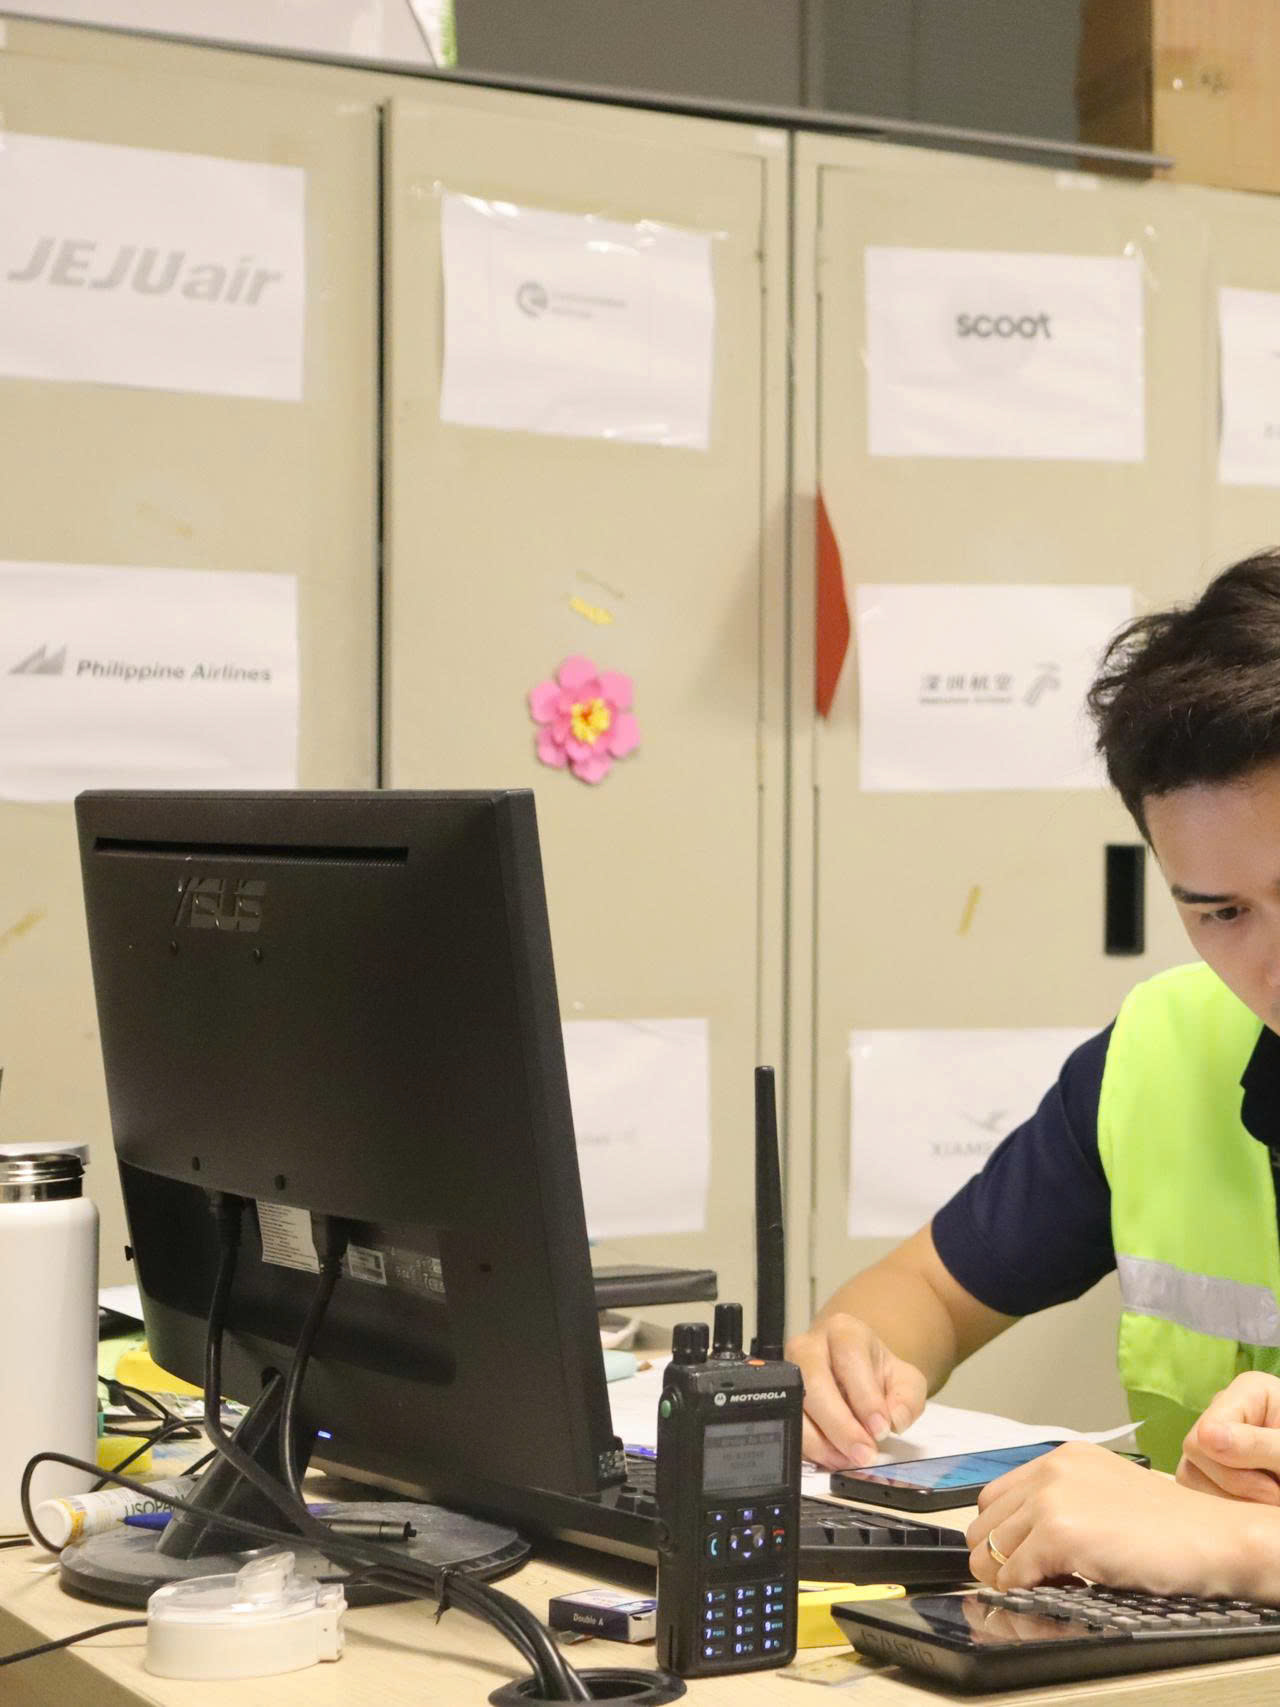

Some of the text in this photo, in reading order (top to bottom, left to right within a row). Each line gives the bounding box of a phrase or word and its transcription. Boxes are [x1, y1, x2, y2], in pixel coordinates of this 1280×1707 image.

[7, 235, 283, 306] JEJUair
[957, 313, 1052, 340] scoot
[76, 659, 272, 682] Philippine Airlines
[730, 1391, 787, 1403] MOTOROLA
[707, 1592, 713, 1603] 1
[737, 1589, 743, 1599] 2
[766, 1585, 772, 1596] 3
[706, 1610, 712, 1621] 4
[737, 1607, 743, 1618] 5
[765, 1603, 771, 1614] 6
[706, 1628, 712, 1639] 7
[736, 1625, 742, 1635] 8
[765, 1621, 771, 1632] 9
[736, 1643, 741, 1654] 0
